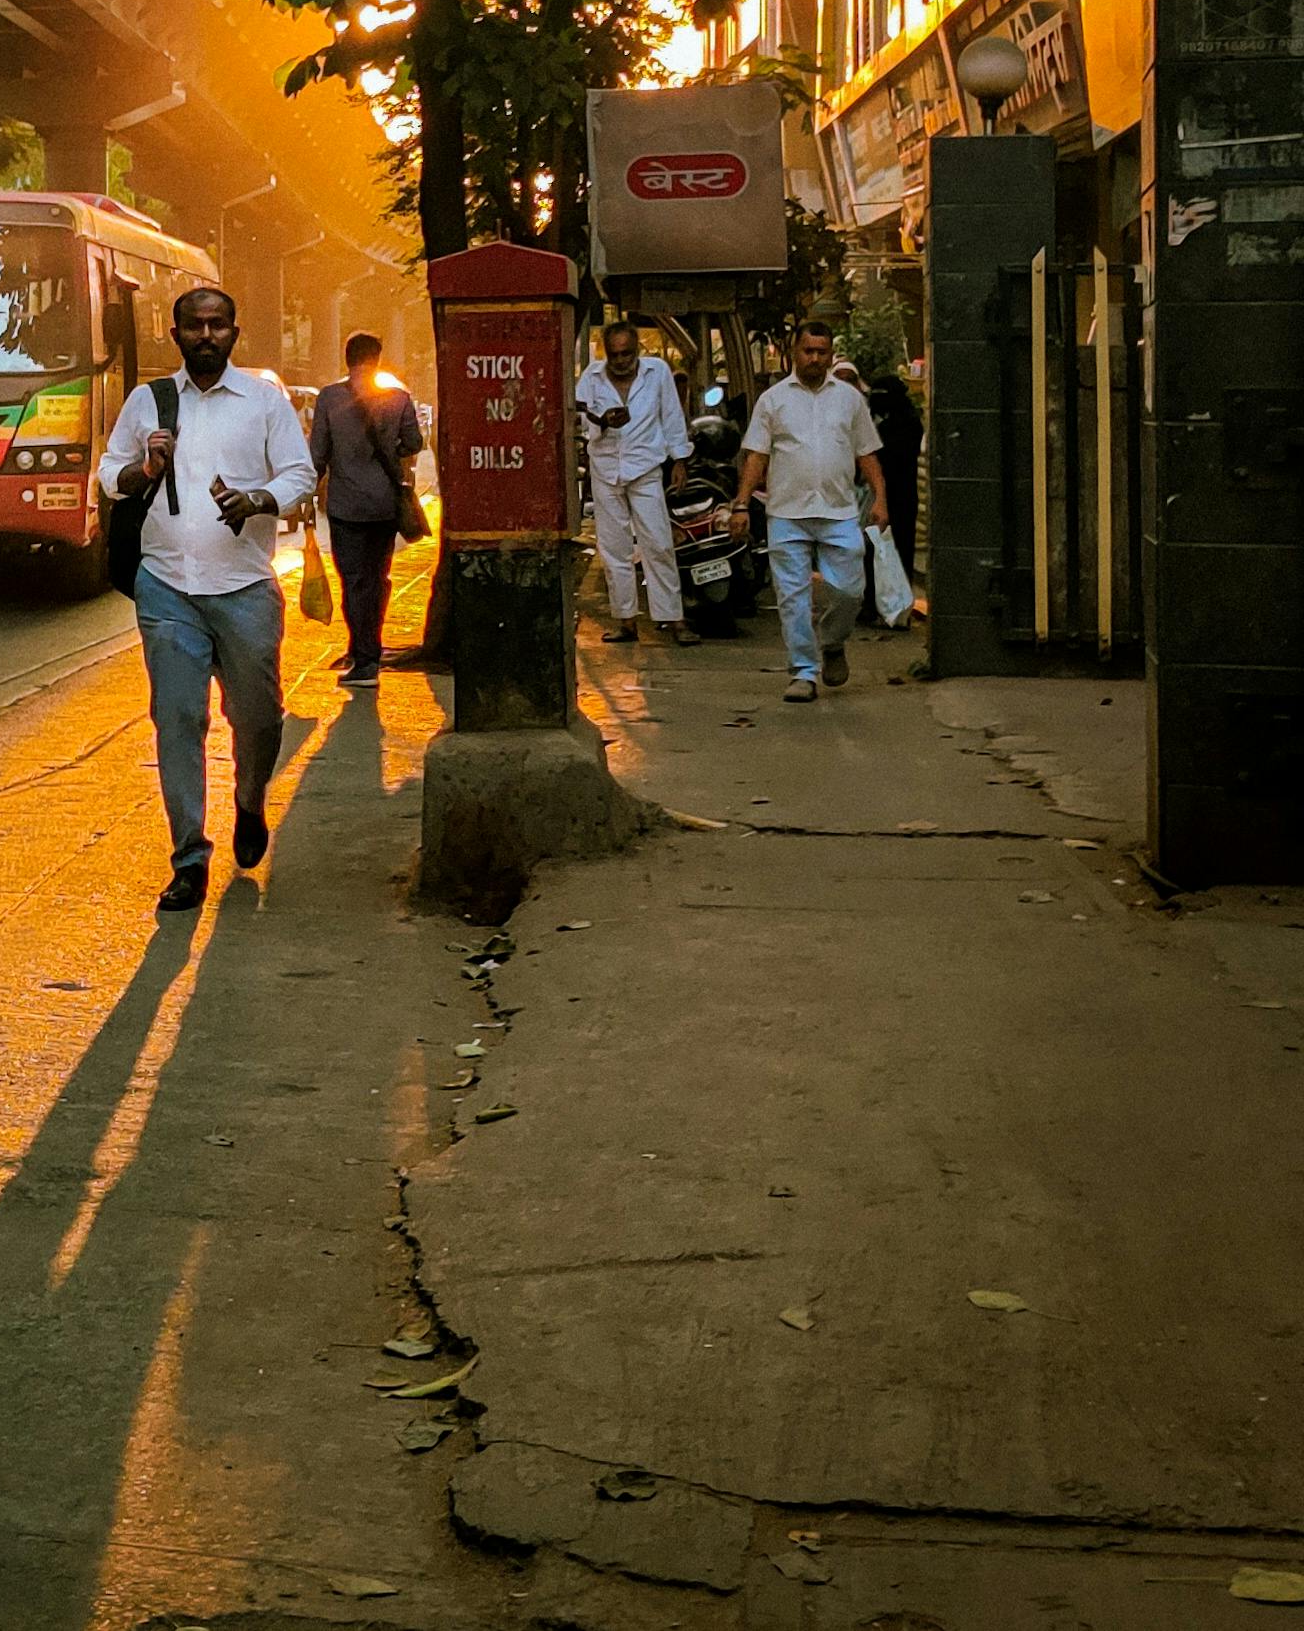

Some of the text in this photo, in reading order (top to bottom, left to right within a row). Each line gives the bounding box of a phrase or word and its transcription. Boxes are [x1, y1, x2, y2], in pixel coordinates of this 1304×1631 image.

[637, 161, 735, 192] बेस्ट
[466, 355, 525, 380] STICK
[486, 398, 515, 422] NO
[470, 445, 525, 470] BILLS
